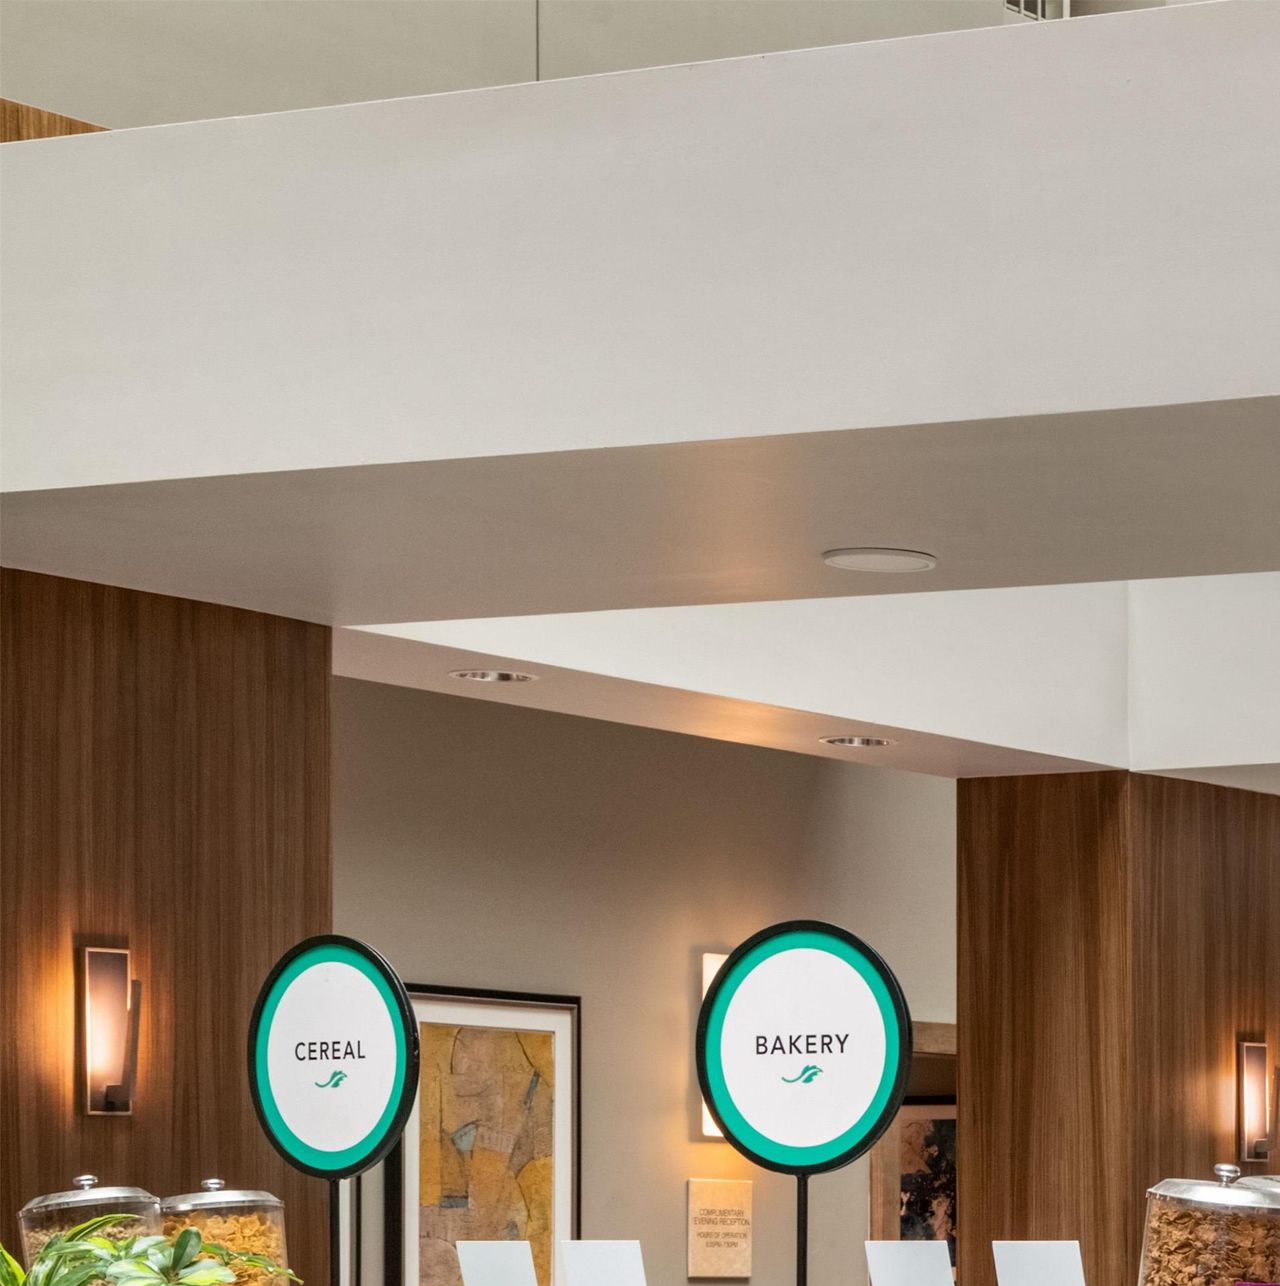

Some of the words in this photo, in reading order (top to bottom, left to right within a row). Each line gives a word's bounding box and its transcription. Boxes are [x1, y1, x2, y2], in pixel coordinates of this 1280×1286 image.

[294, 1040, 366, 1061] CEREAL
[755, 1033, 849, 1055] BAKERY
[693, 1216, 718, 1225] EVENING
[719, 1217, 750, 1226] RECEPTION
